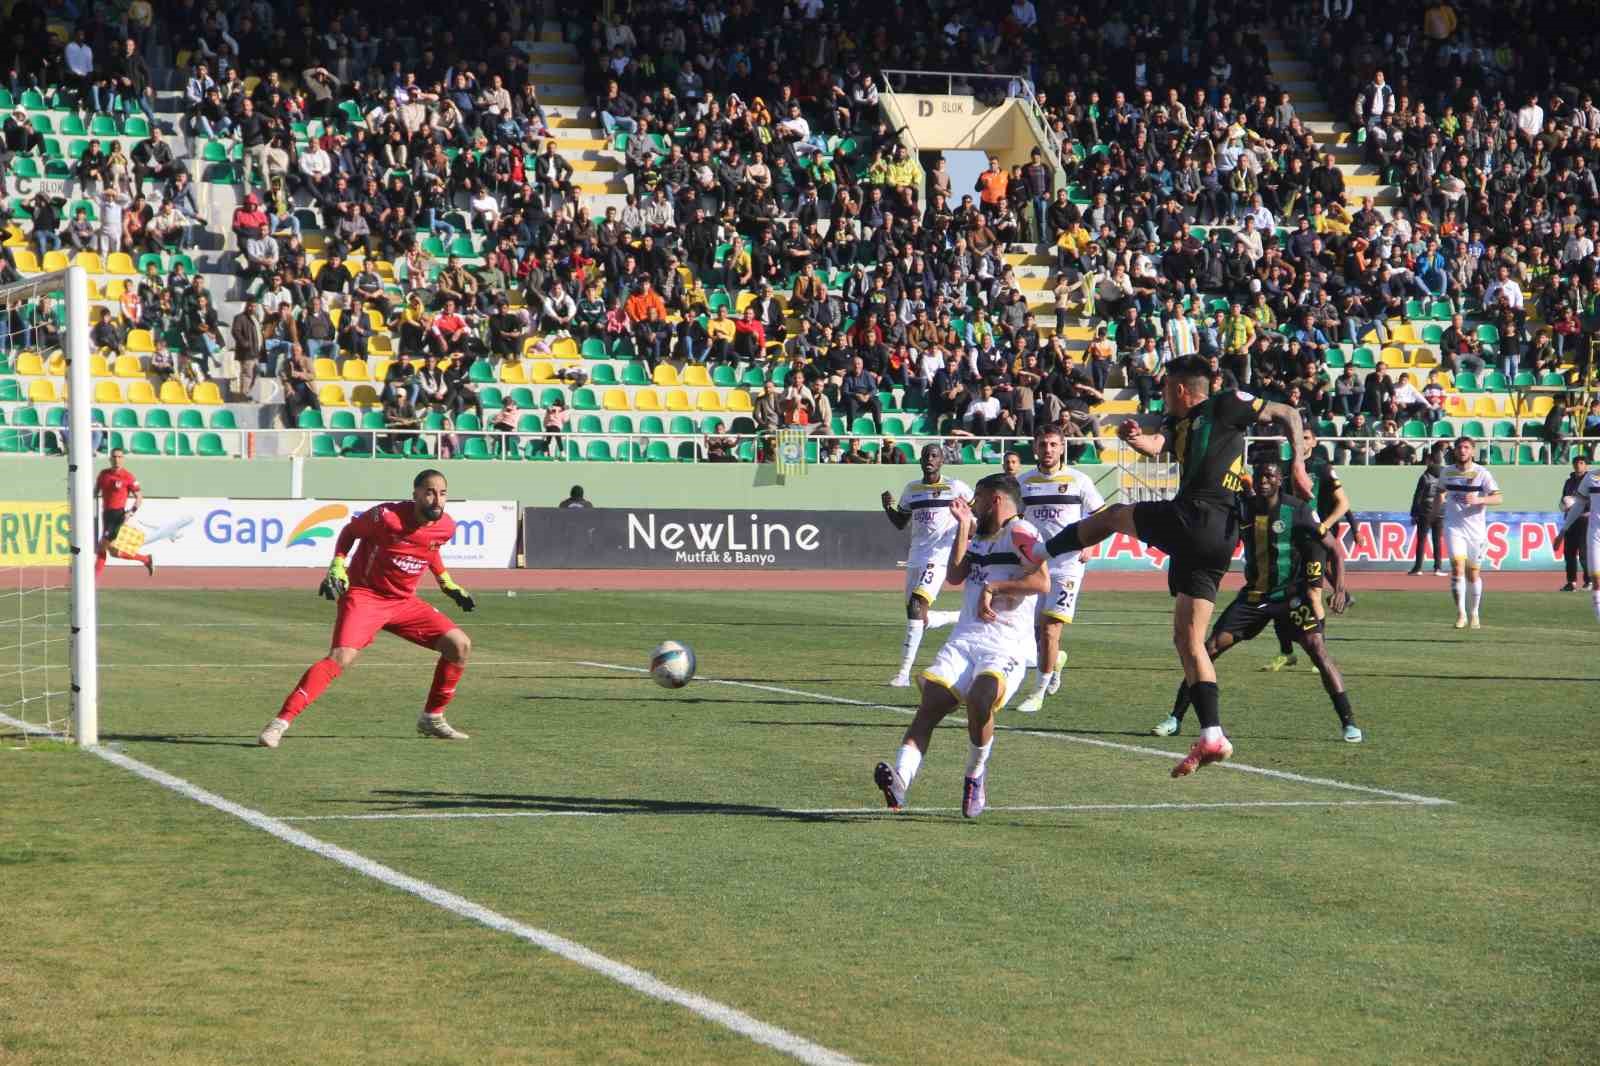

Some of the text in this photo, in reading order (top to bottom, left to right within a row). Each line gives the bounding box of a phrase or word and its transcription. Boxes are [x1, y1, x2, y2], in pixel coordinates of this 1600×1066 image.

[918, 100, 963, 117] D BLOK
[16, 178, 32, 194] C
[204, 509, 284, 552] Gap
[628, 513, 820, 551] NewLine
[675, 551, 776, 566] Mutfak & Banyo
[1306, 561, 1321, 576] 82
[1289, 604, 1315, 626] 32
